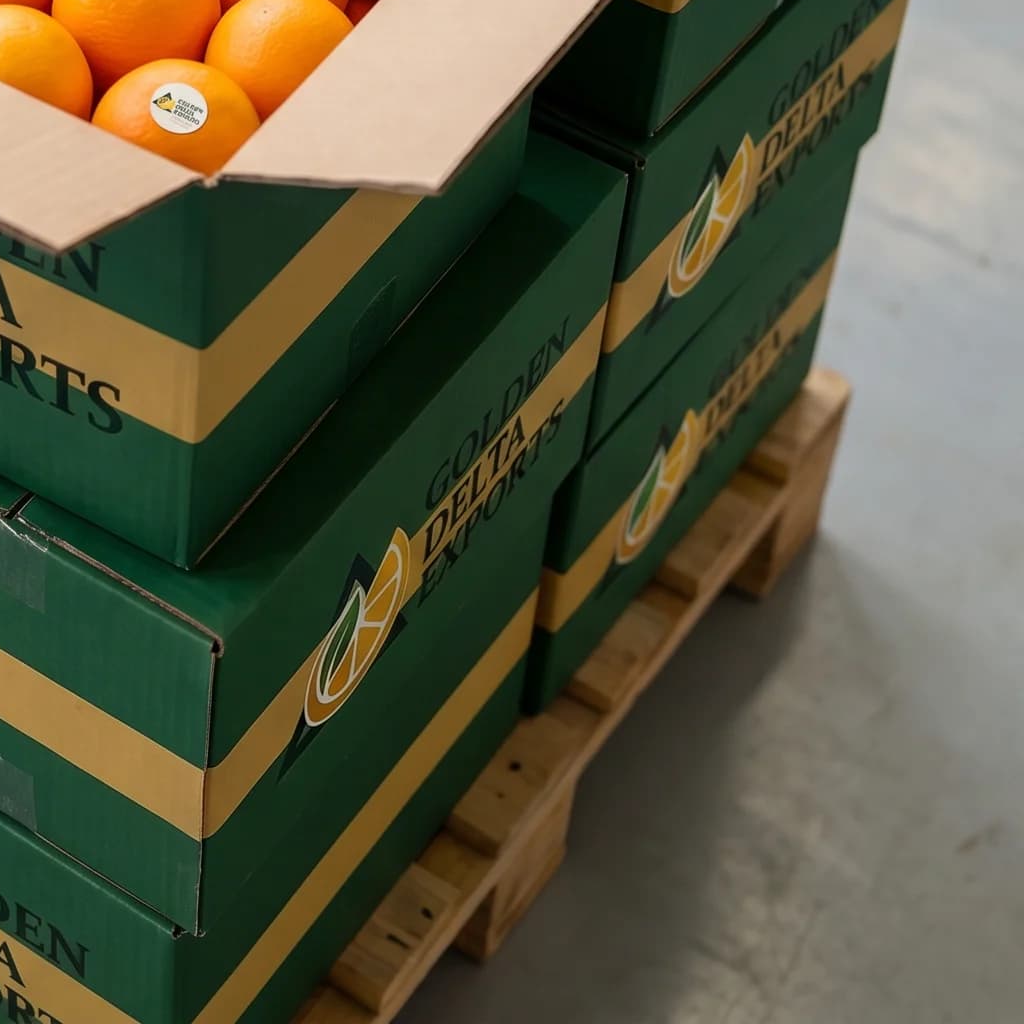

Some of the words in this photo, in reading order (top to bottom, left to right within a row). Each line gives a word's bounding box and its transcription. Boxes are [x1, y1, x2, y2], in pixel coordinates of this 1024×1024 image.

[417, 398, 566, 608] EXPORTS
[423, 415, 525, 564] DELTA
[424, 314, 571, 511] GOLDEN
